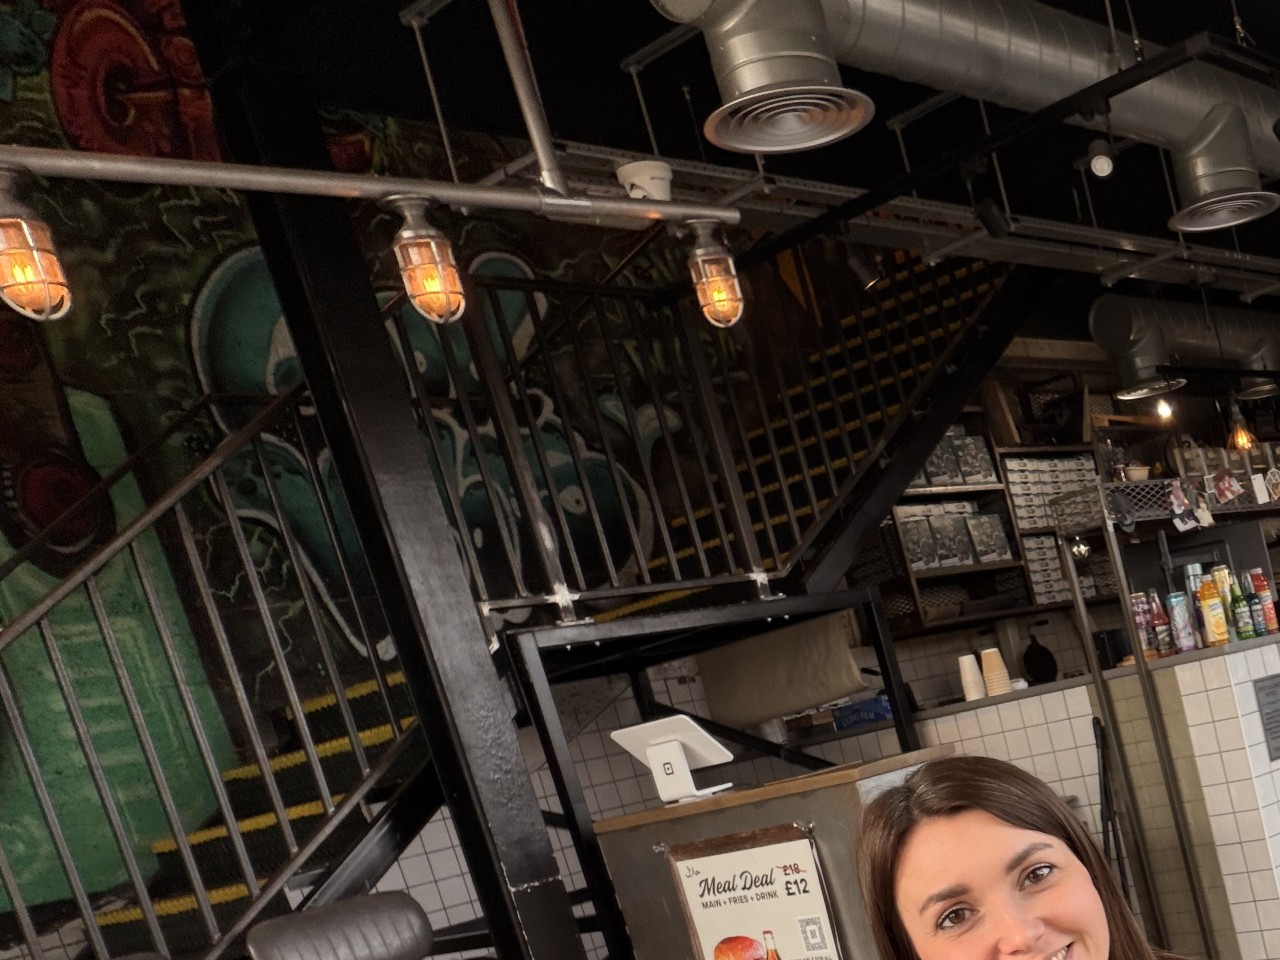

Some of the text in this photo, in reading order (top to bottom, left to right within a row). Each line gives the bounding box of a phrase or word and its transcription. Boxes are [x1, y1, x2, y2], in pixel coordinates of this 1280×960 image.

[699, 876, 739, 898] Meal
[740, 868, 775, 891] Deal
[785, 878, 810, 896] £12
[701, 897, 722, 909] MAIN
[728, 894, 750, 907] FRIES
[755, 890, 779, 901] DRINK
